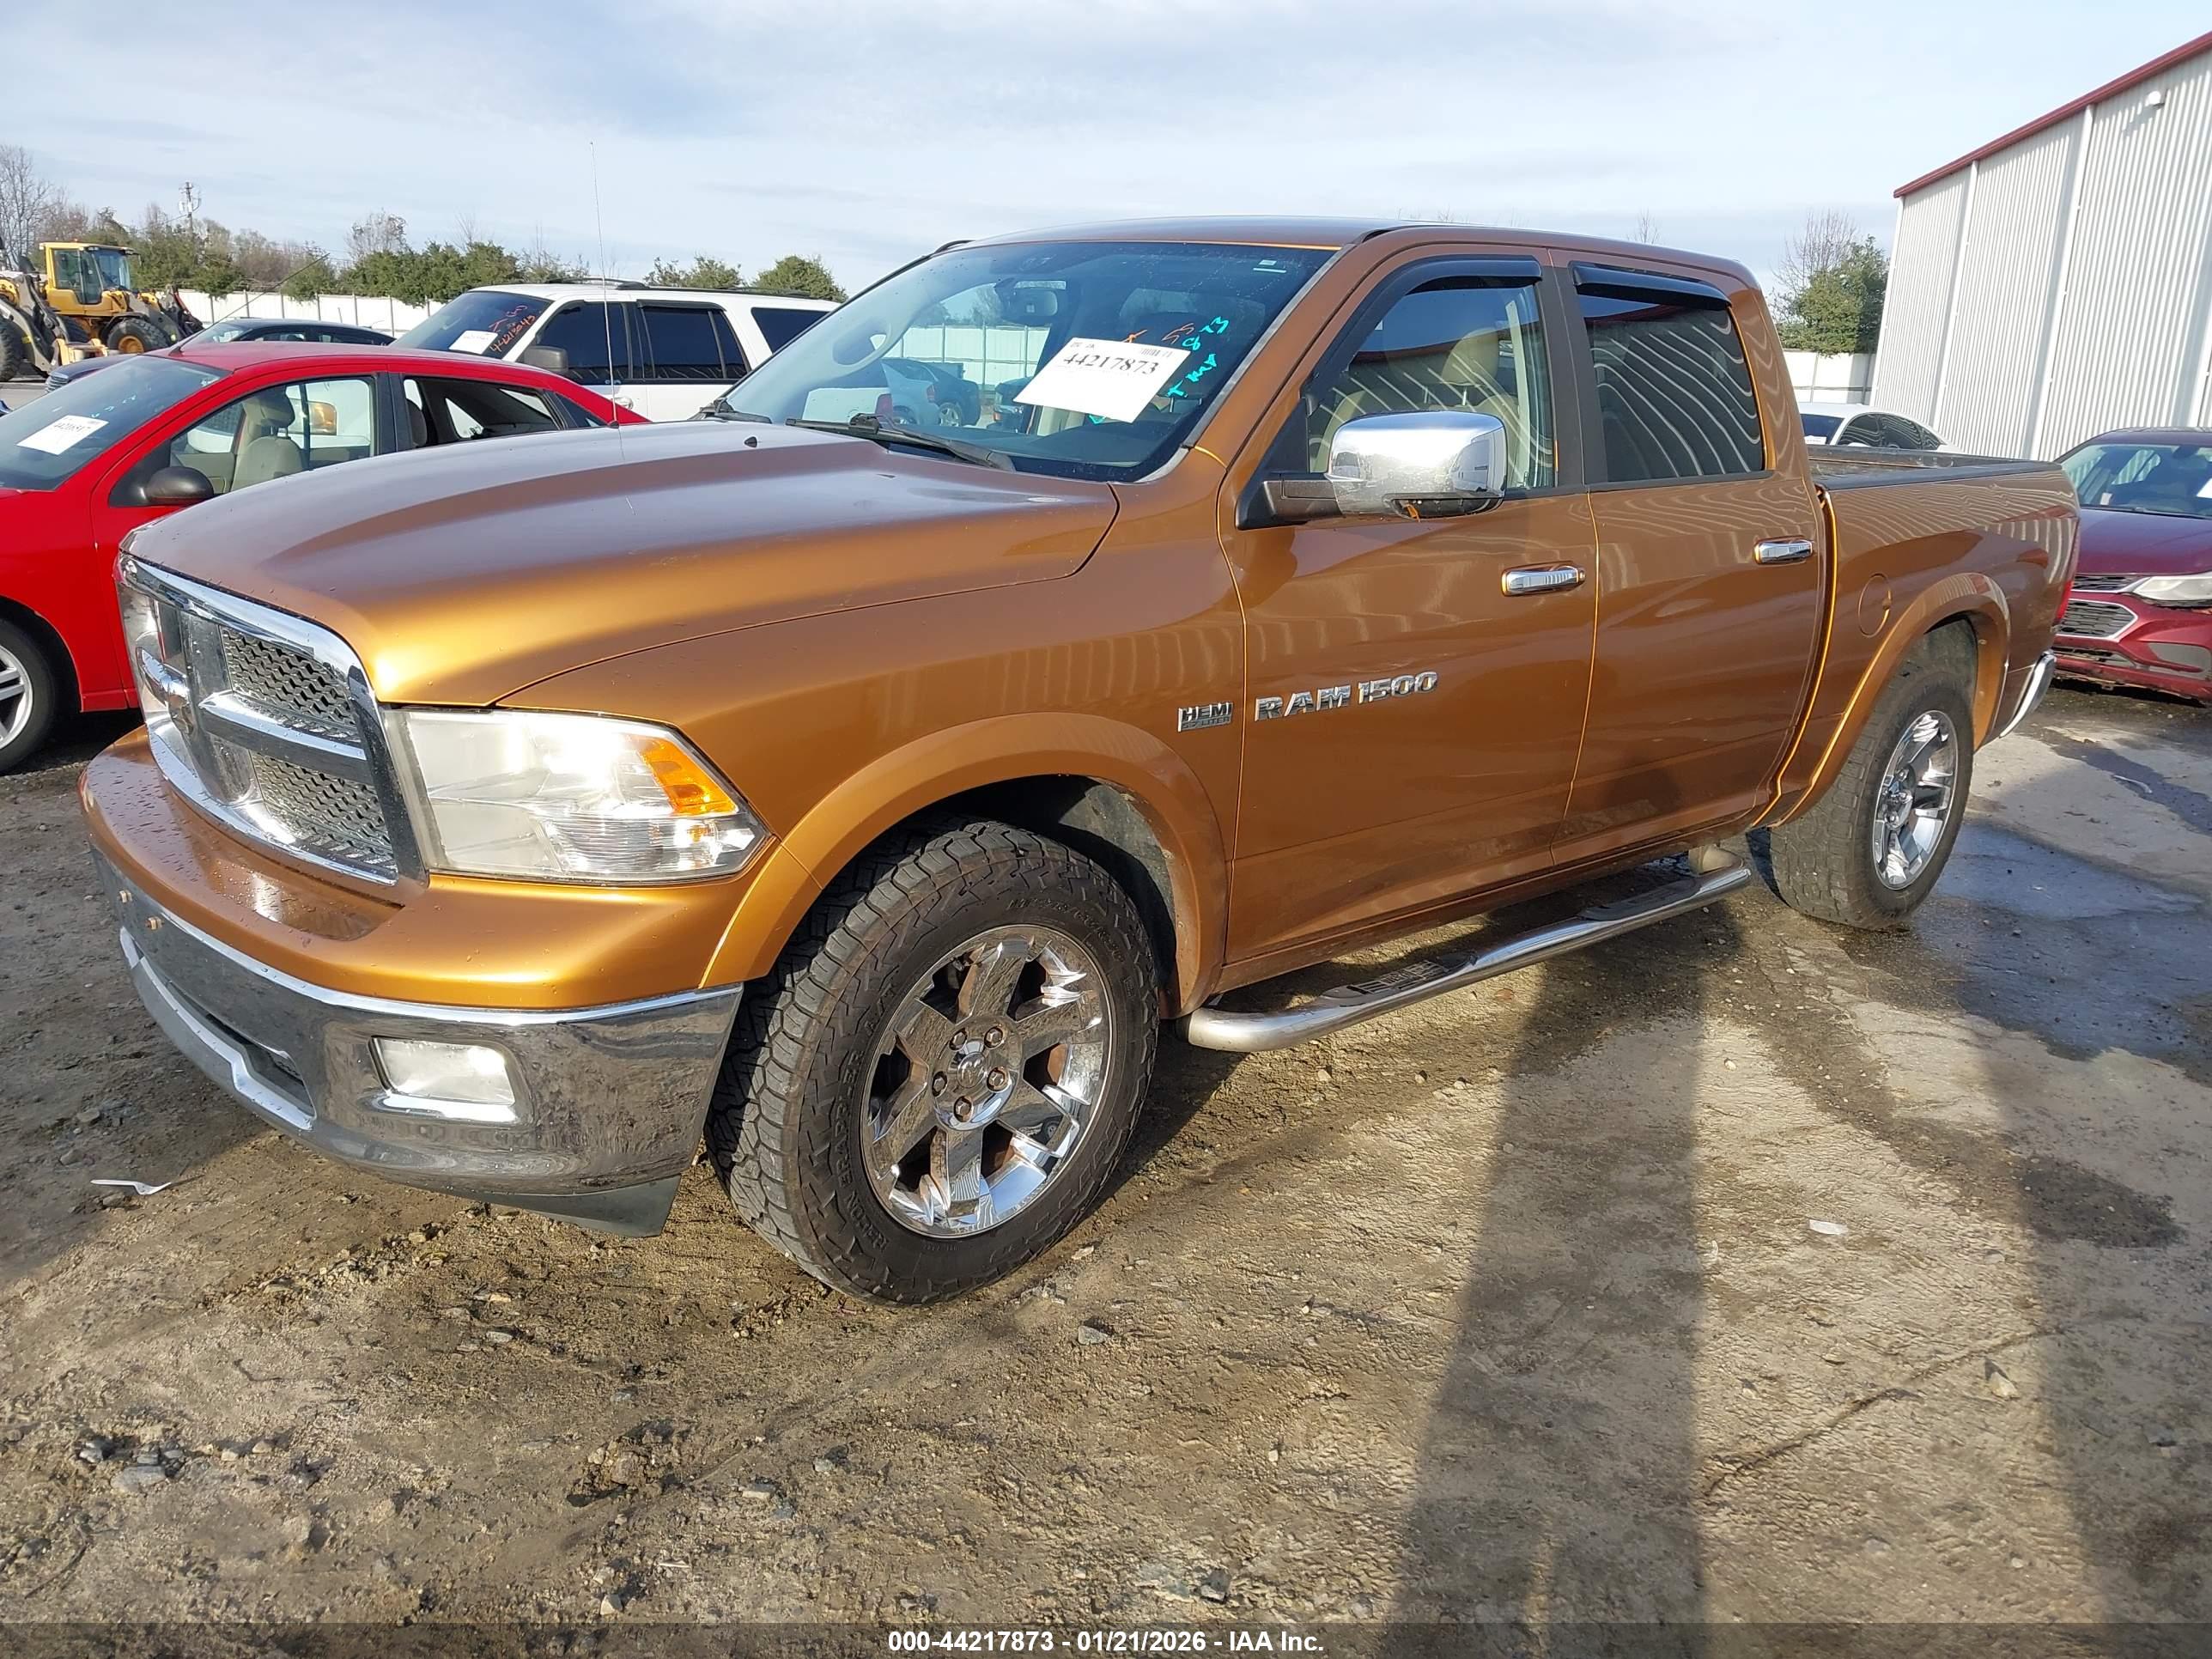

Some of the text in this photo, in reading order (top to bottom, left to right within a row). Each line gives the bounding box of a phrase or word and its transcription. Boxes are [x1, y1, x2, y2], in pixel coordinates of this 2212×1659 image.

[1063, 353, 1160, 375] 44217873
[1254, 671, 1438, 722] RAM 1500
[1177, 702, 1234, 724] HEMI
